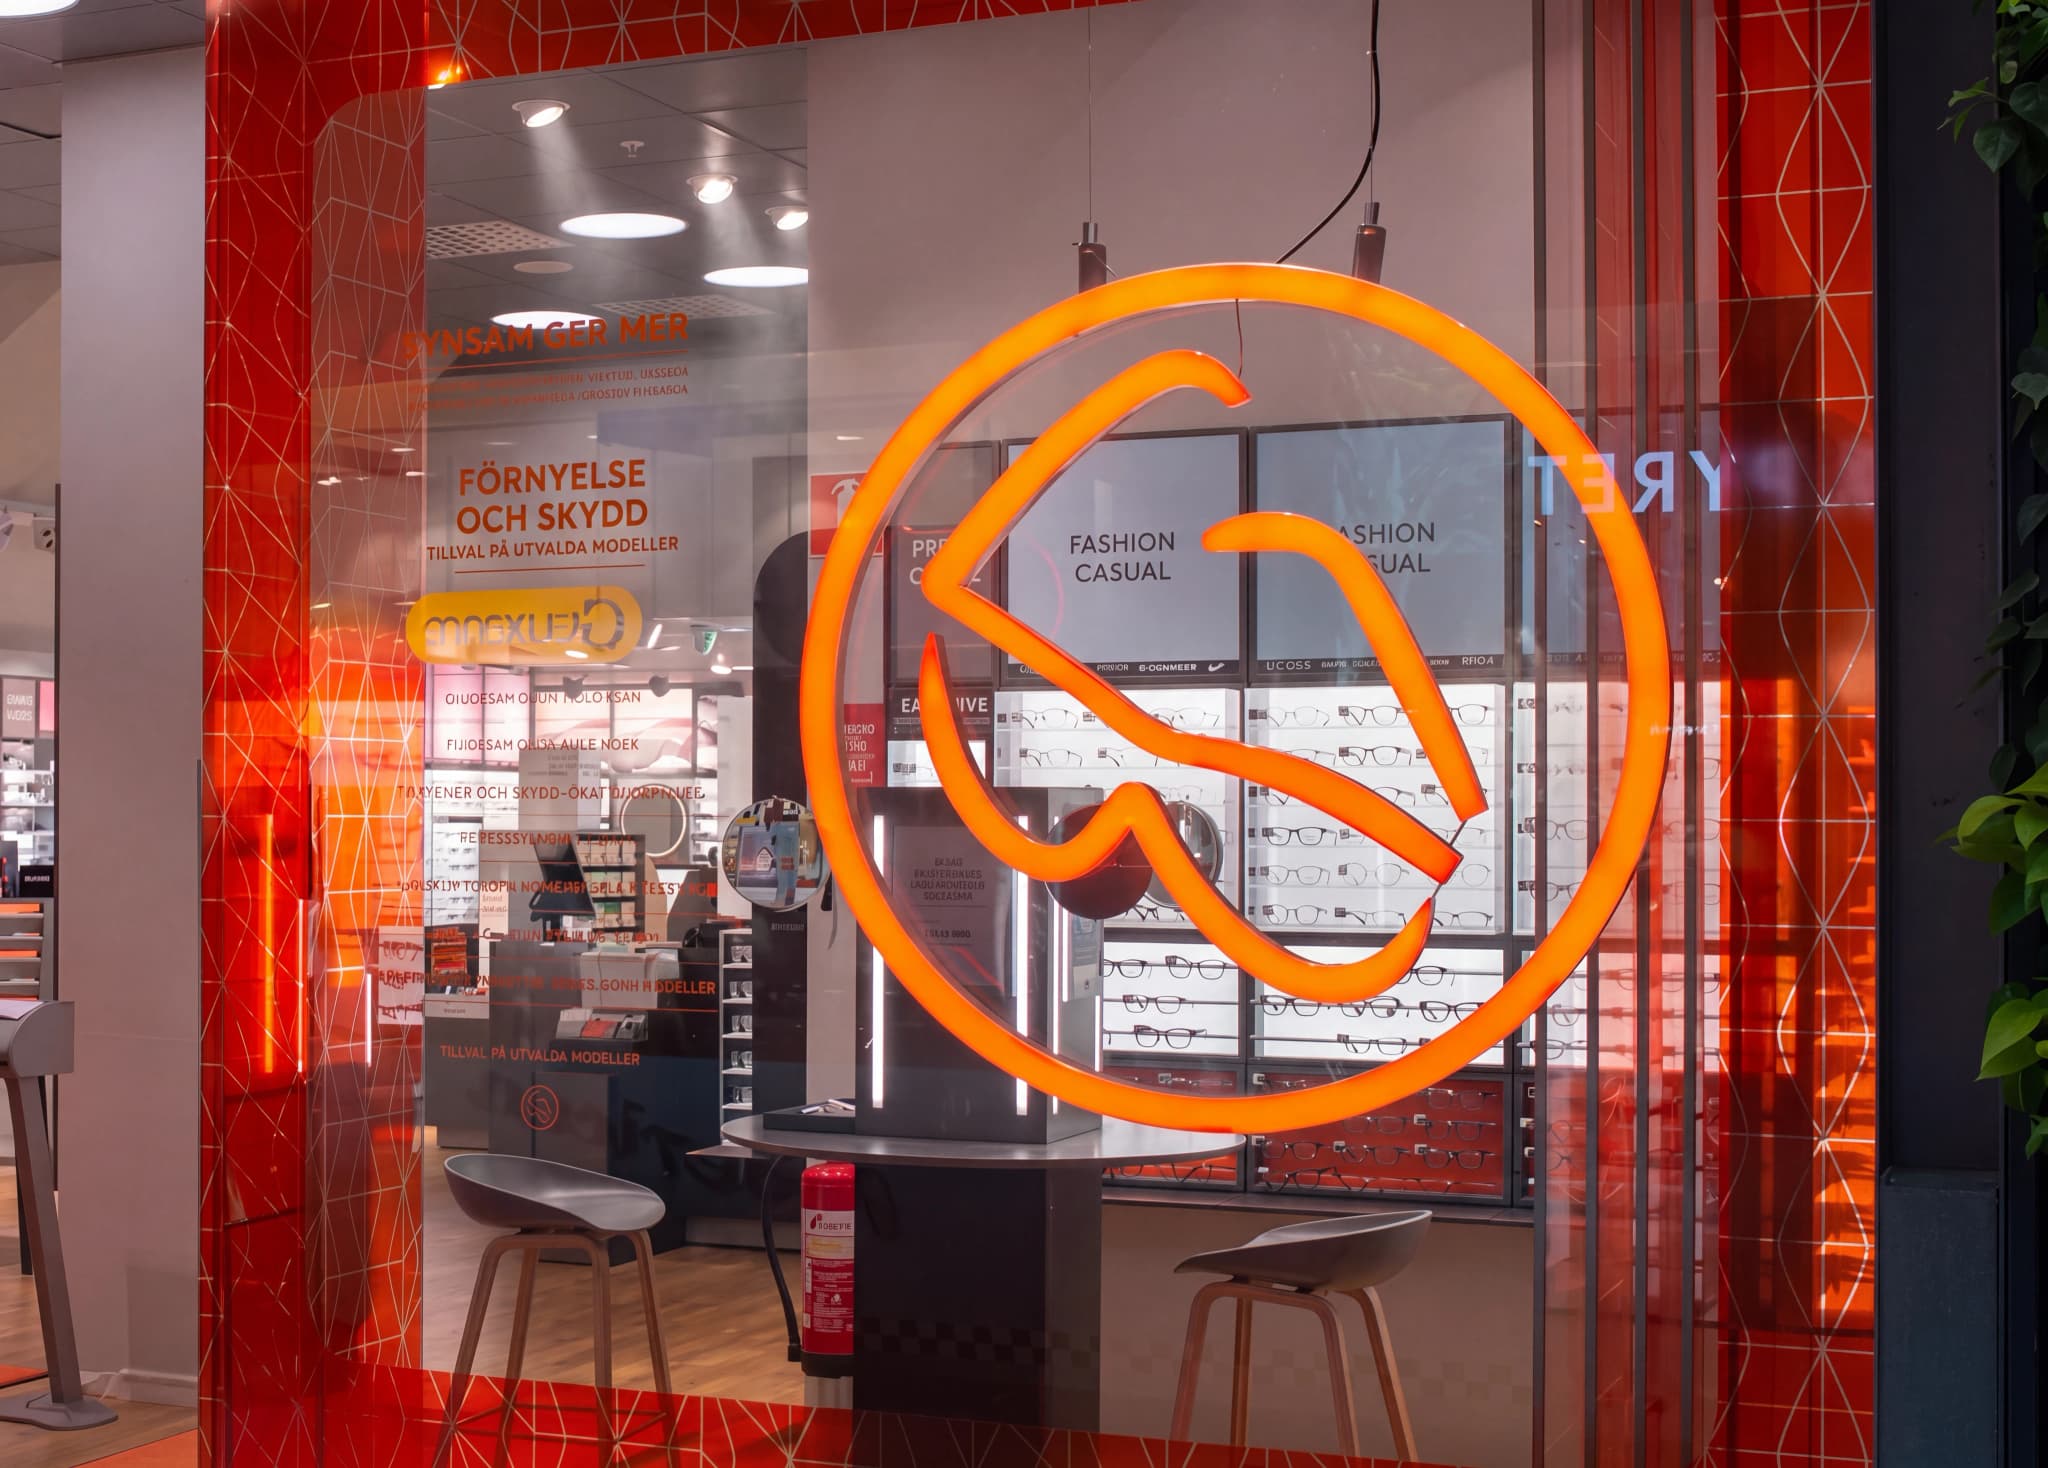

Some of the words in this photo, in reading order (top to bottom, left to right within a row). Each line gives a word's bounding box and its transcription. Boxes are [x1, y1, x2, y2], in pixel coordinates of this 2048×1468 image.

[402, 323, 534, 360] SYNSAM
[543, 317, 607, 350] GER
[619, 312, 689, 344] MER
[459, 459, 646, 496] FÖRNYELSE
[456, 503, 527, 534] OCH
[536, 498, 648, 531] SKYDD
[427, 545, 485, 560] TILLVAL
[489, 541, 510, 558] PÅ
[513, 540, 588, 557] UTVALDA
[592, 536, 679, 555] MODELLER
[1070, 531, 1175, 554] FASHION
[1074, 561, 1171, 582] CASUAL
[476, 786, 508, 799] OCH
[440, 1045, 487, 1059] TILLVAL
[491, 1044, 507, 1060] PÅ
[510, 1048, 568, 1063] UTVALDA
[571, 1051, 641, 1066] MODELLER
